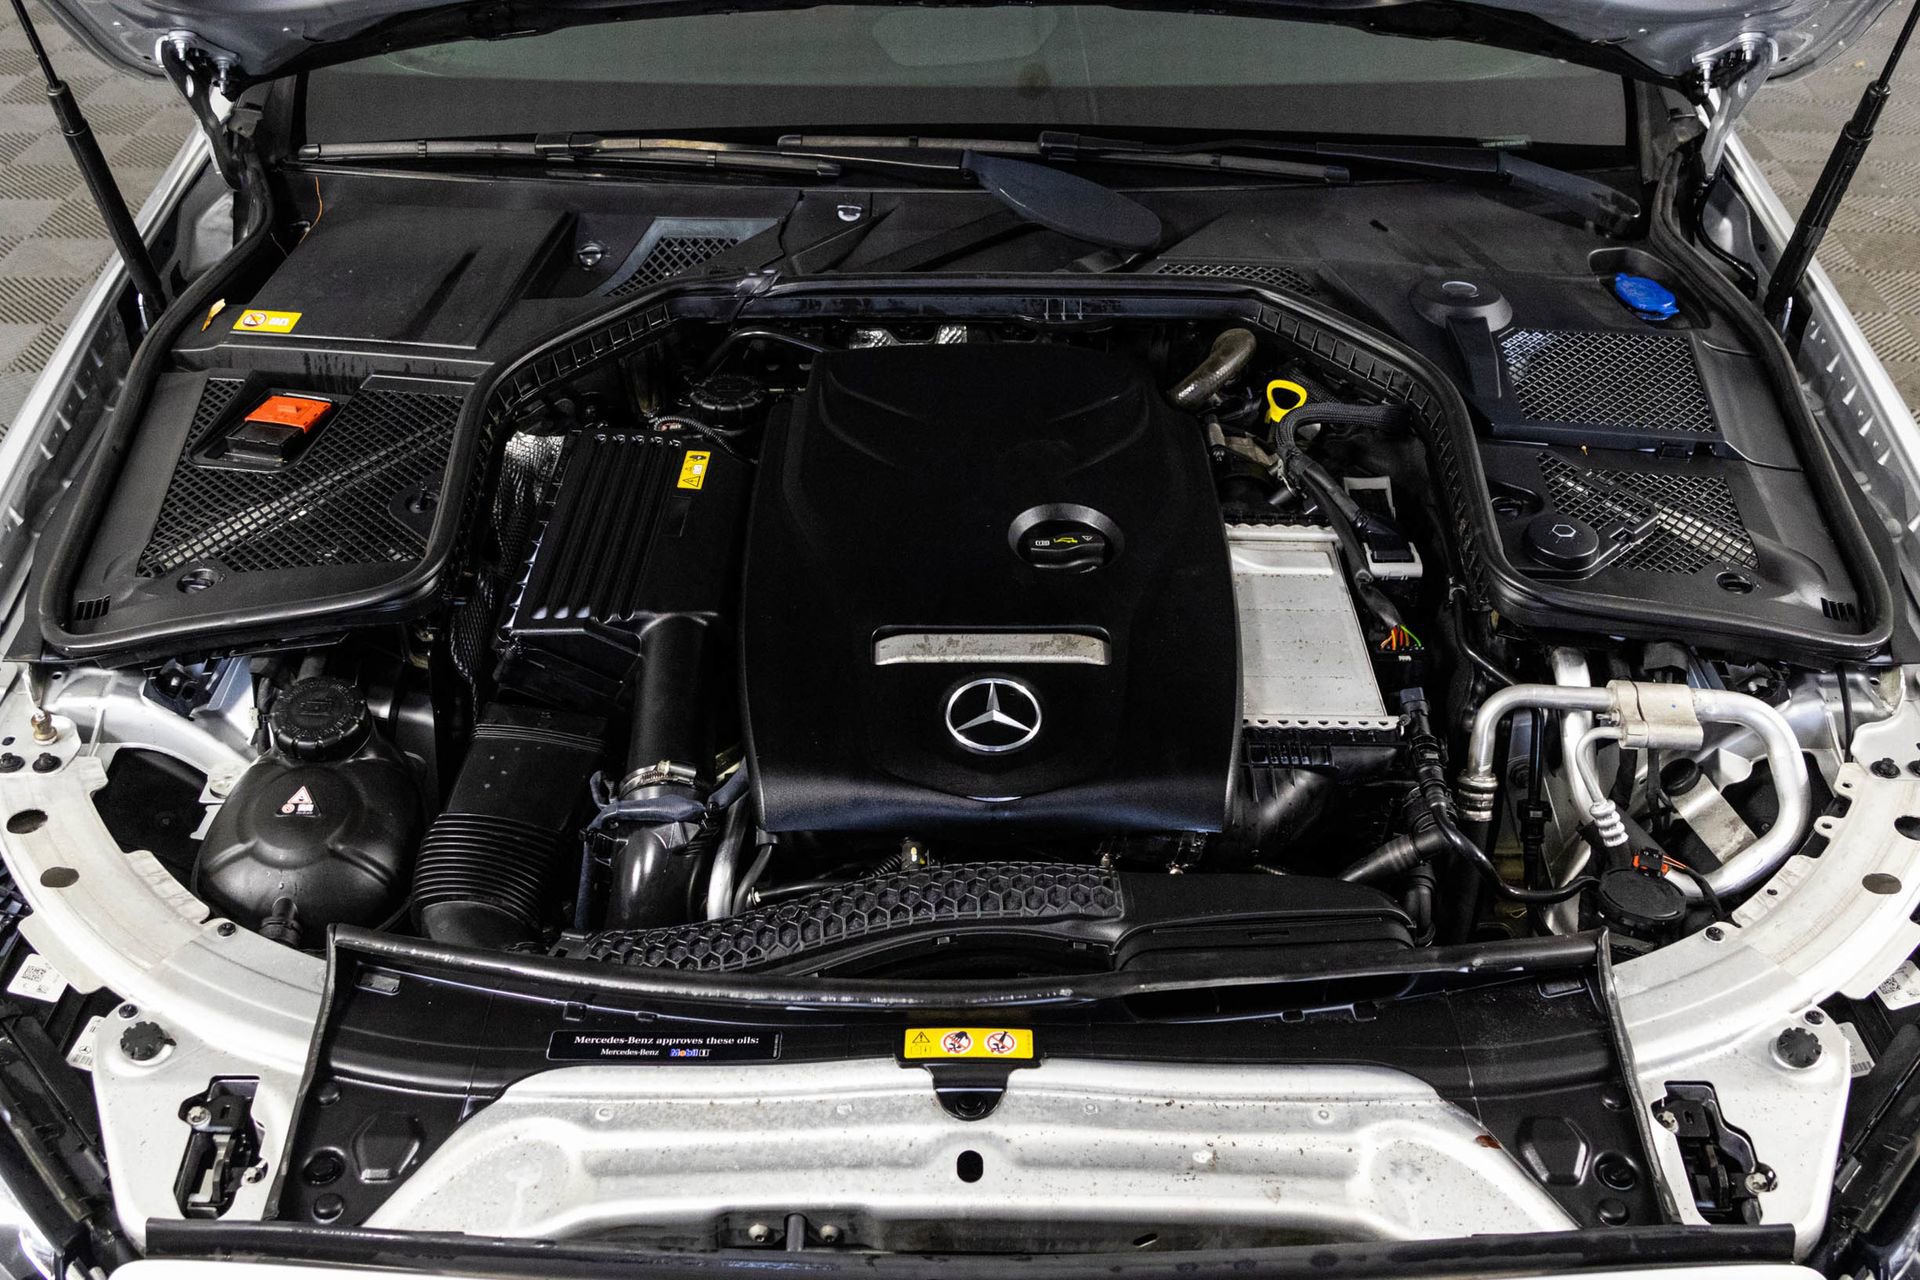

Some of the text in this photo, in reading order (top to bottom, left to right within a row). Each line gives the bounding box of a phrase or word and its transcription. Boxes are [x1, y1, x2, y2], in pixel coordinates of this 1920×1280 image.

[574, 1036, 759, 1046] Mercedes-Benz approves these oils:
[600, 1048, 659, 1056] Mercedes-Benz
[670, 1048, 699, 1057] Mobil
